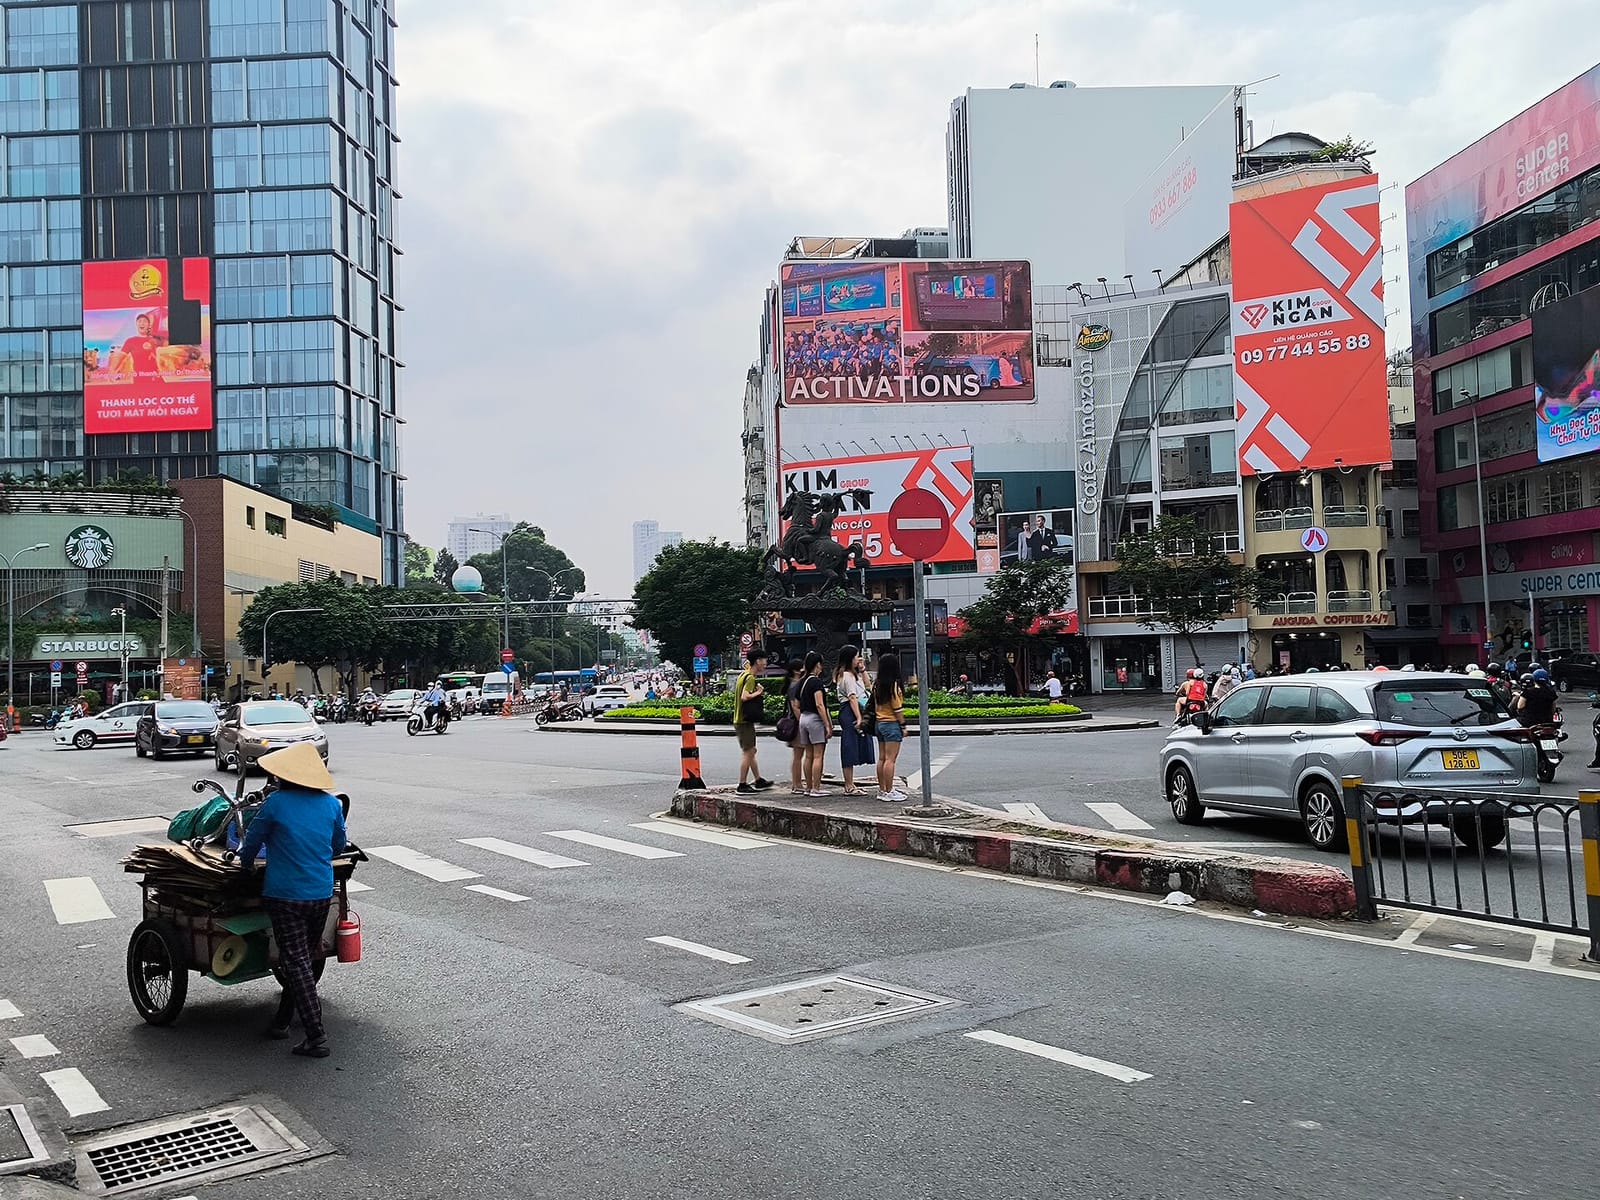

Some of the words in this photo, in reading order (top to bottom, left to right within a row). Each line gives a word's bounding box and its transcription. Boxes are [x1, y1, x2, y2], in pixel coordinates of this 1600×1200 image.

[1272, 295, 1311, 313] KIM
[1273, 306, 1333, 326] NGAN
[1241, 349, 1263, 364] 09
[1266, 345, 1289, 361] 77
[1291, 341, 1314, 357] 44
[1318, 338, 1341, 354] 55
[1345, 333, 1371, 350] 88
[790, 374, 981, 399] ACTIVATIONS
[101, 399, 136, 408] THANH
[1079, 357, 1097, 457] Amazon
[785, 469, 838, 493] KIM
[840, 479, 870, 489] GROUP
[1080, 463, 1099, 515] Café
[1272, 616, 1318, 626] AUGUDA
[1323, 614, 1365, 624] COFFEE
[1365, 613, 1389, 624] 24/7
[1448, 759, 1476, 768] 128.10
